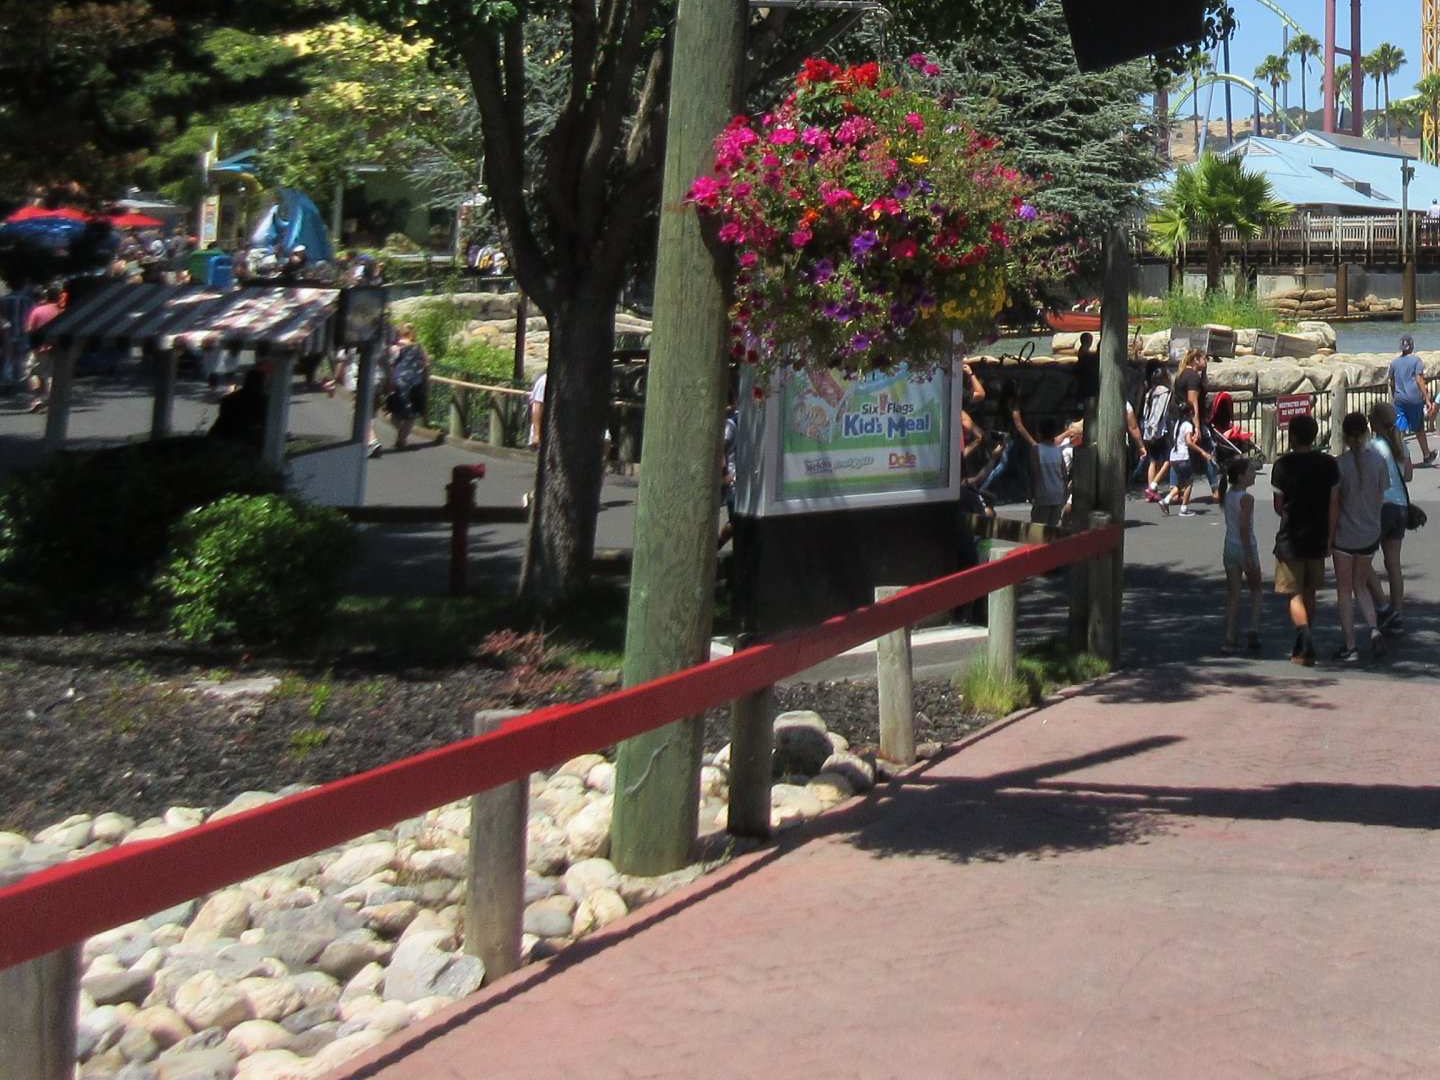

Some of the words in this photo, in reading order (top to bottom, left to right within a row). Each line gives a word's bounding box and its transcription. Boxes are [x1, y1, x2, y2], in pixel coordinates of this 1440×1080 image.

[862, 403, 878, 414] Six
[887, 403, 914, 414] Flags
[844, 414, 882, 436] Kid's
[887, 414, 929, 438] Meal
[889, 452, 916, 466] Dole
